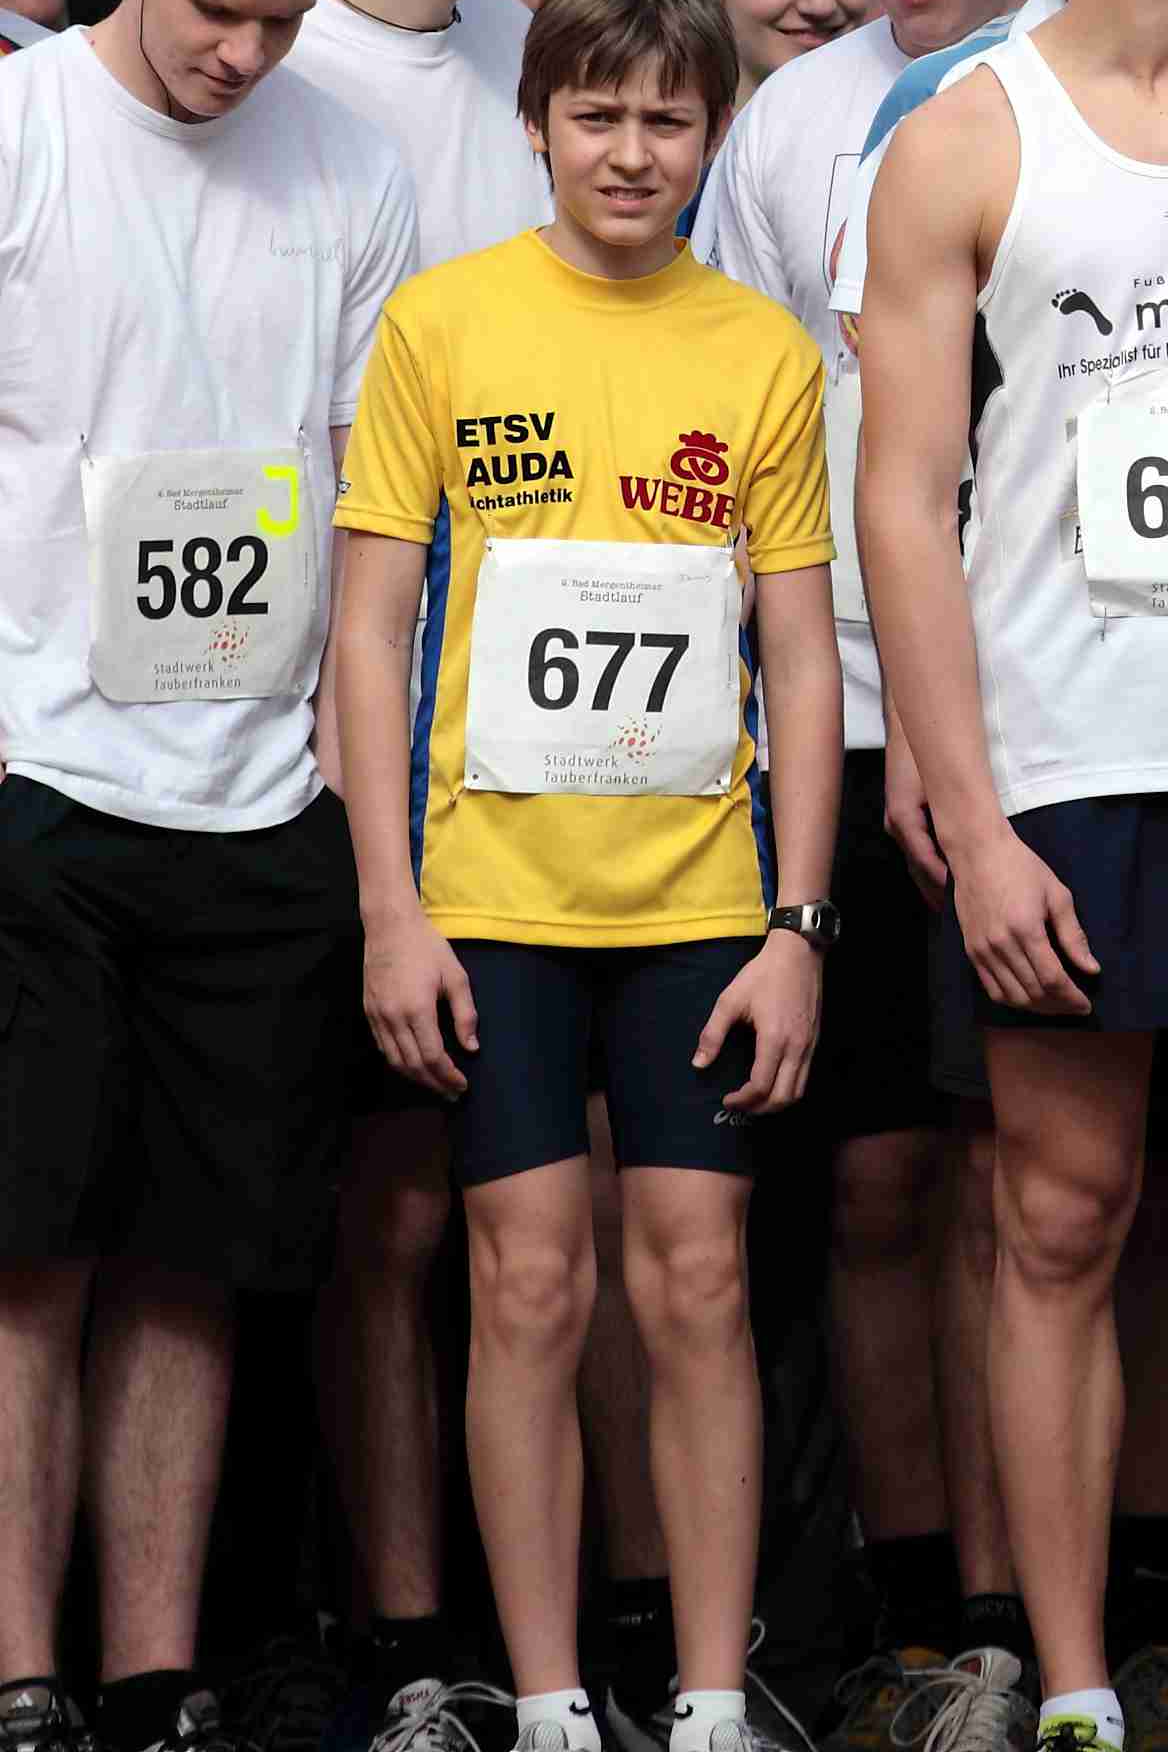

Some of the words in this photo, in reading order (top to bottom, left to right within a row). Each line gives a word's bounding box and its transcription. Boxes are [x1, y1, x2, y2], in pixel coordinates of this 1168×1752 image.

[1058, 361, 1077, 379] Ihr
[1080, 345, 1138, 375] Spezialist
[1142, 343, 1161, 360] für
[456, 411, 555, 448] ETSV
[174, 498, 230, 511] Stadtlauf
[136, 535, 269, 620] 582
[580, 589, 644, 604] Stadtlauf
[153, 661, 215, 674] Stadtwerk
[527, 627, 690, 714] 677
[154, 676, 241, 691] Tauberfranken
[543, 754, 619, 769] Stadtwerk
[544, 771, 650, 787] Tauberfranken
